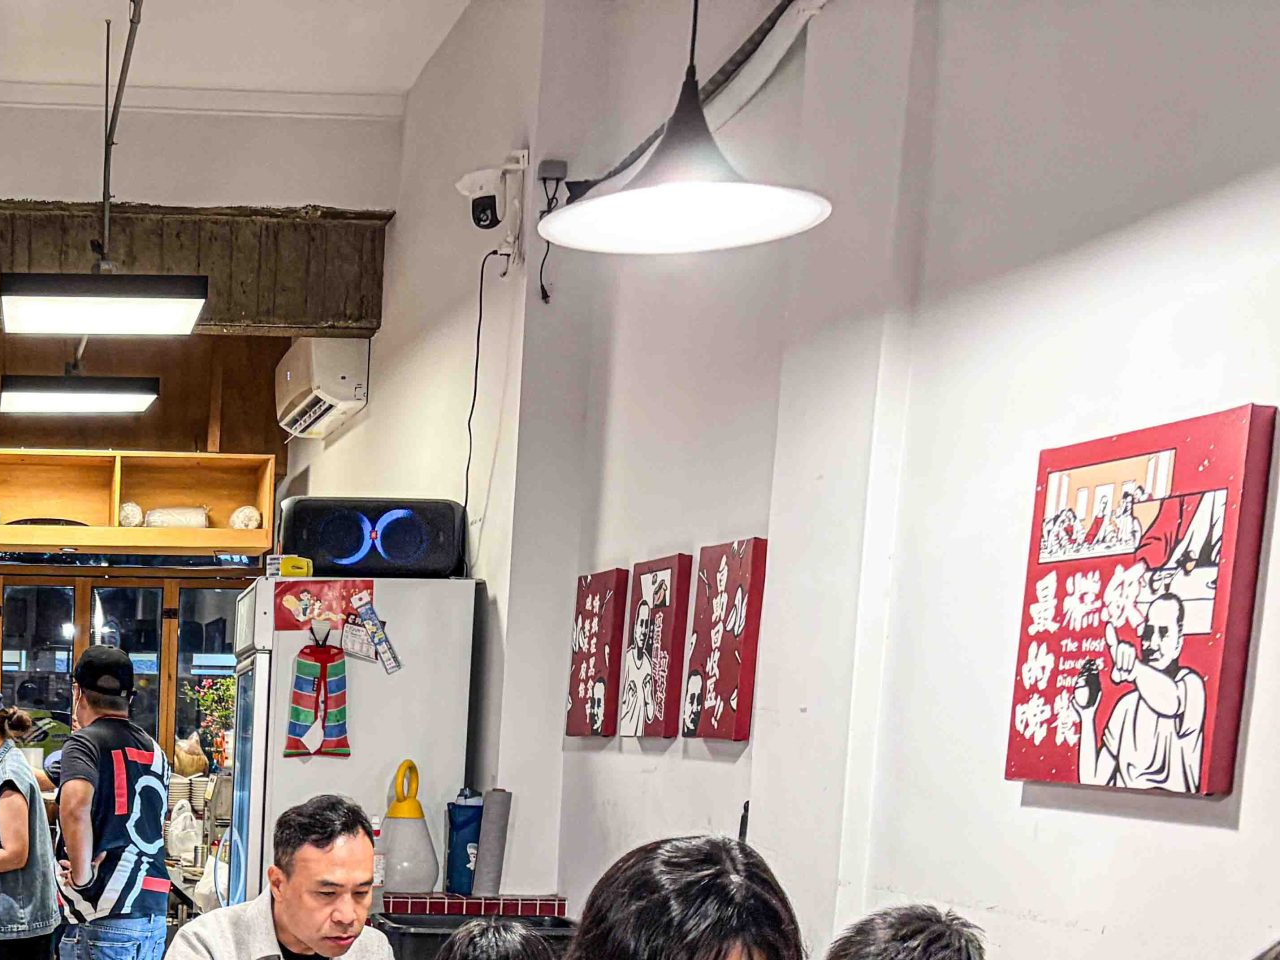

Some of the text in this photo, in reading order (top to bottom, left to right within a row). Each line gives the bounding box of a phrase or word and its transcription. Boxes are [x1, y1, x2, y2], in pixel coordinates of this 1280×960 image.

[1021, 640, 1055, 691] 的
[1060, 637, 1106, 653] The Most
[1014, 689, 1081, 747] 晚餐
